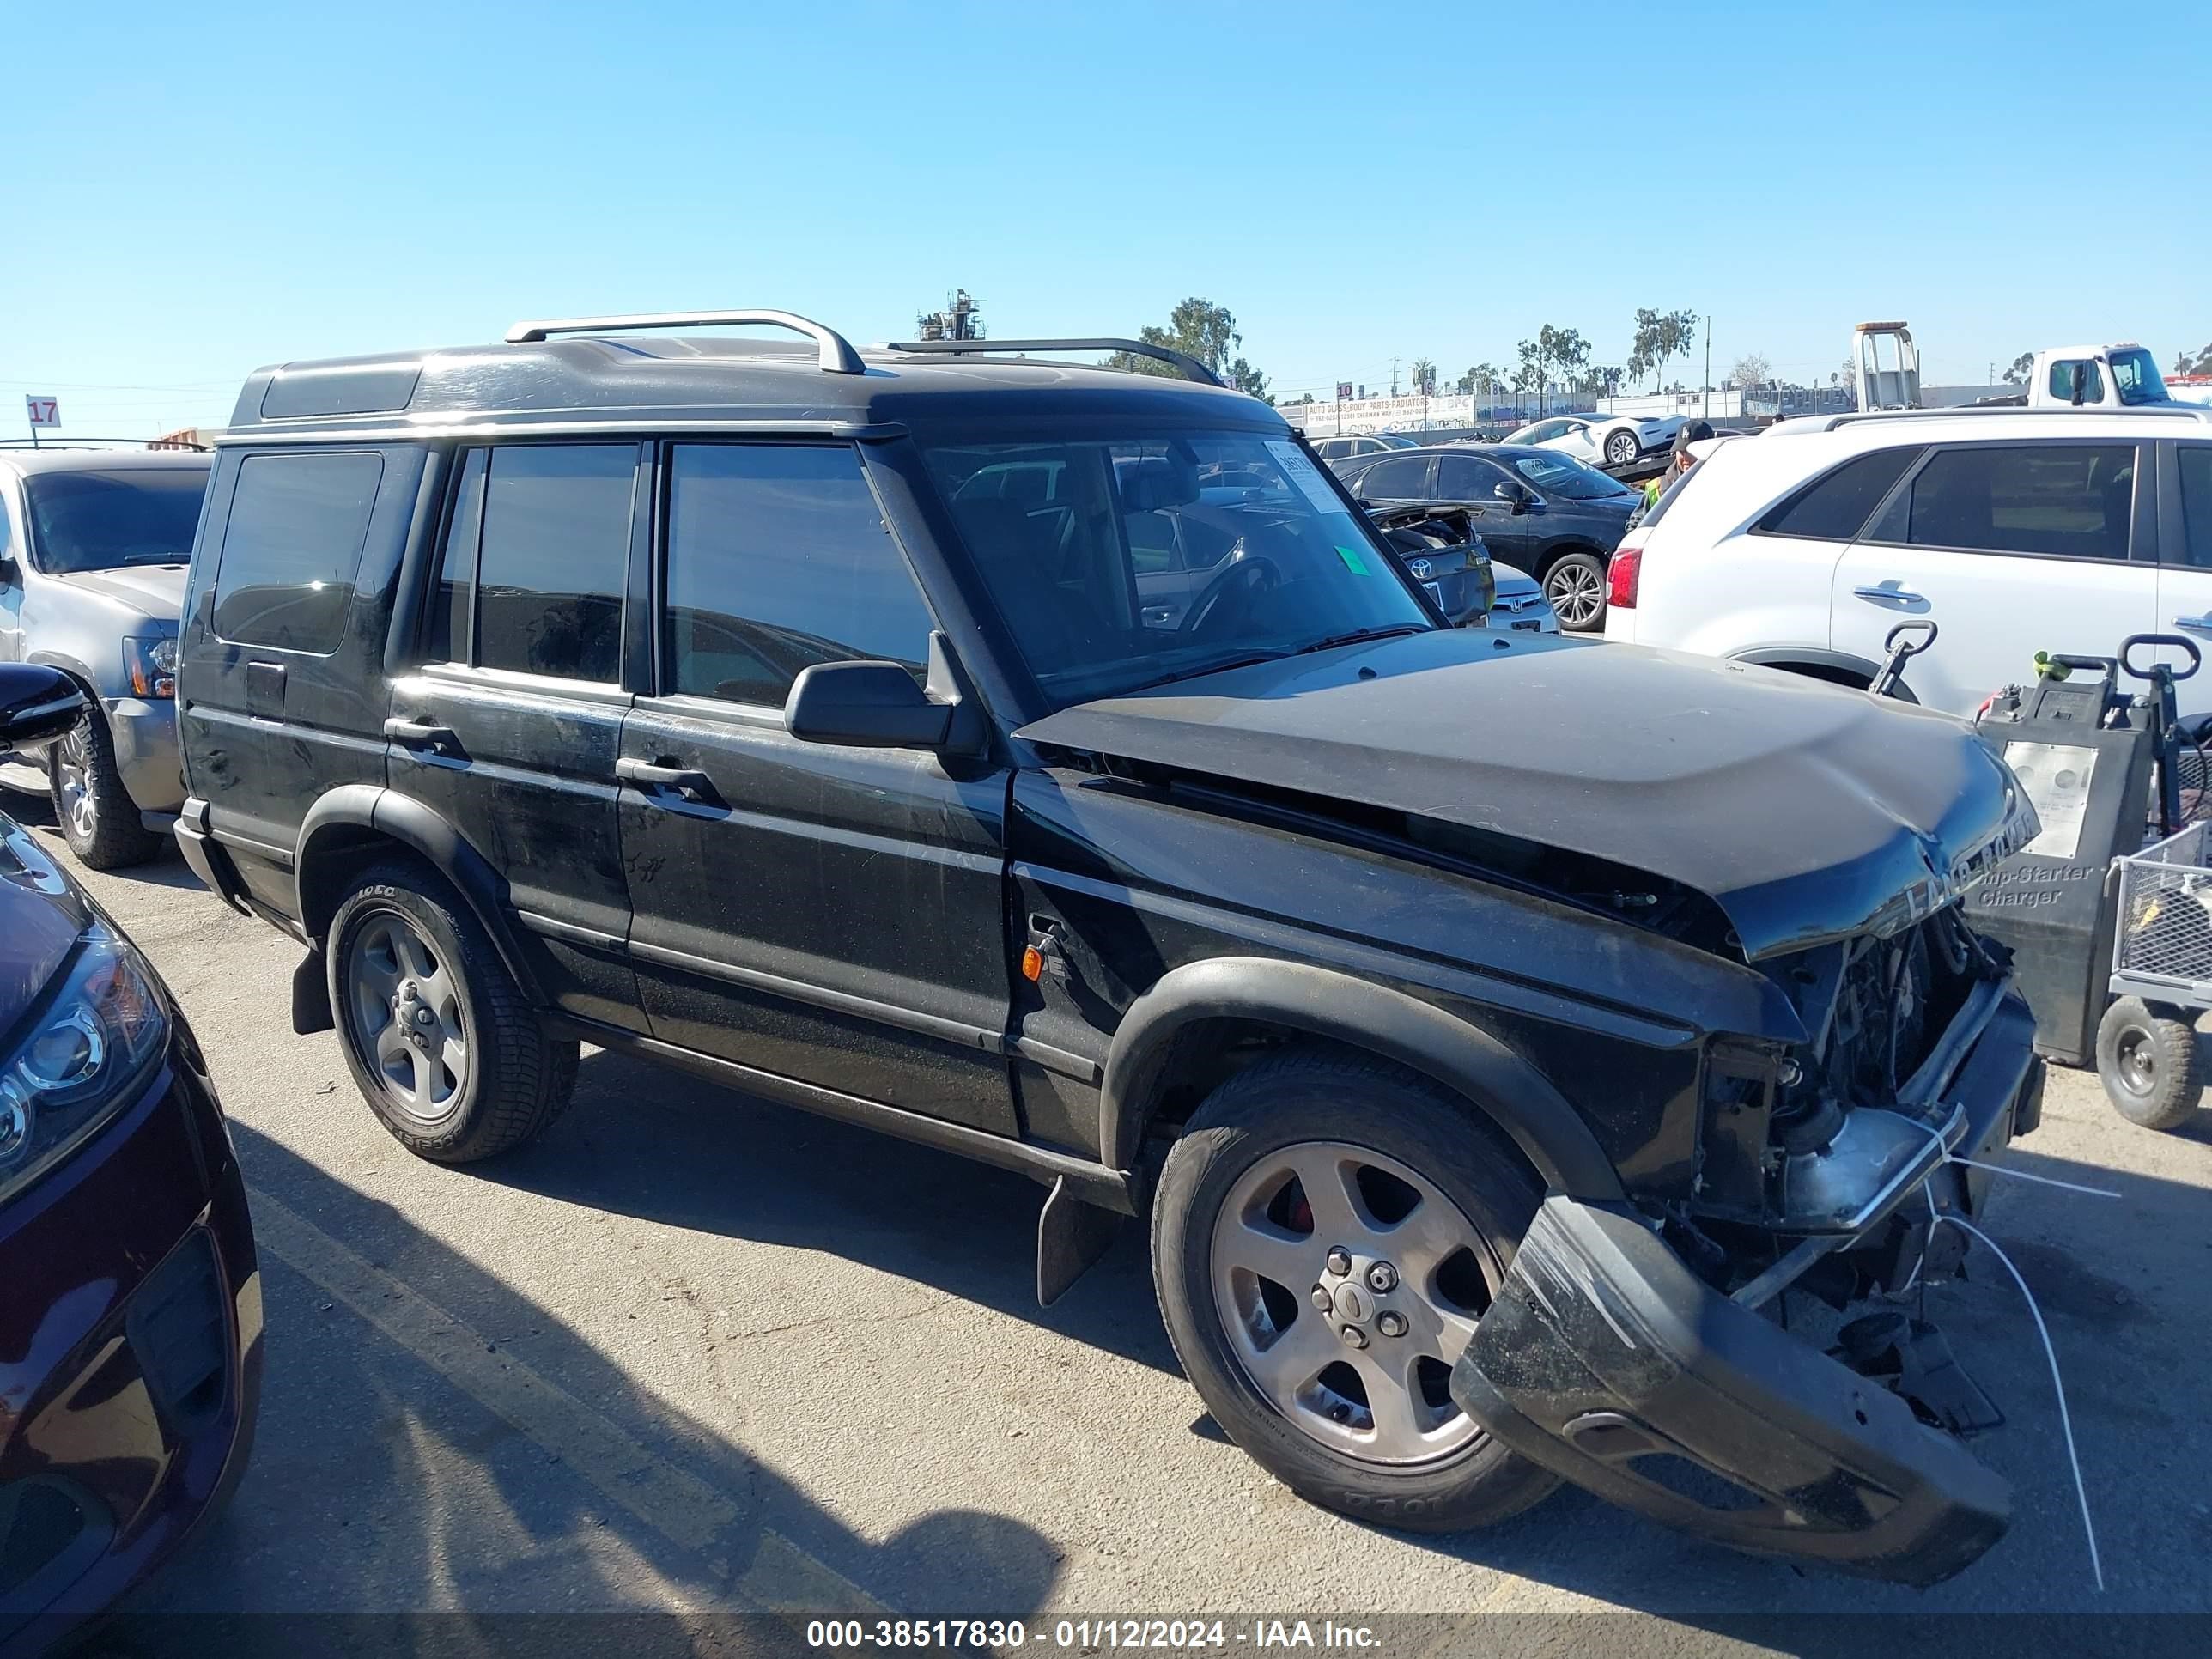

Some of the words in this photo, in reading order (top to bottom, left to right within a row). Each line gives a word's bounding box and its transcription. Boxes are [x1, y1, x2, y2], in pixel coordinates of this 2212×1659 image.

[1338, 385, 1352, 398] 10
[1426, 382, 1433, 395] 9
[1492, 383, 1499, 395] 8
[28, 401, 57, 422] 17
[1310, 404, 1325, 414] AUTO
[1978, 890, 2063, 908] Charger
